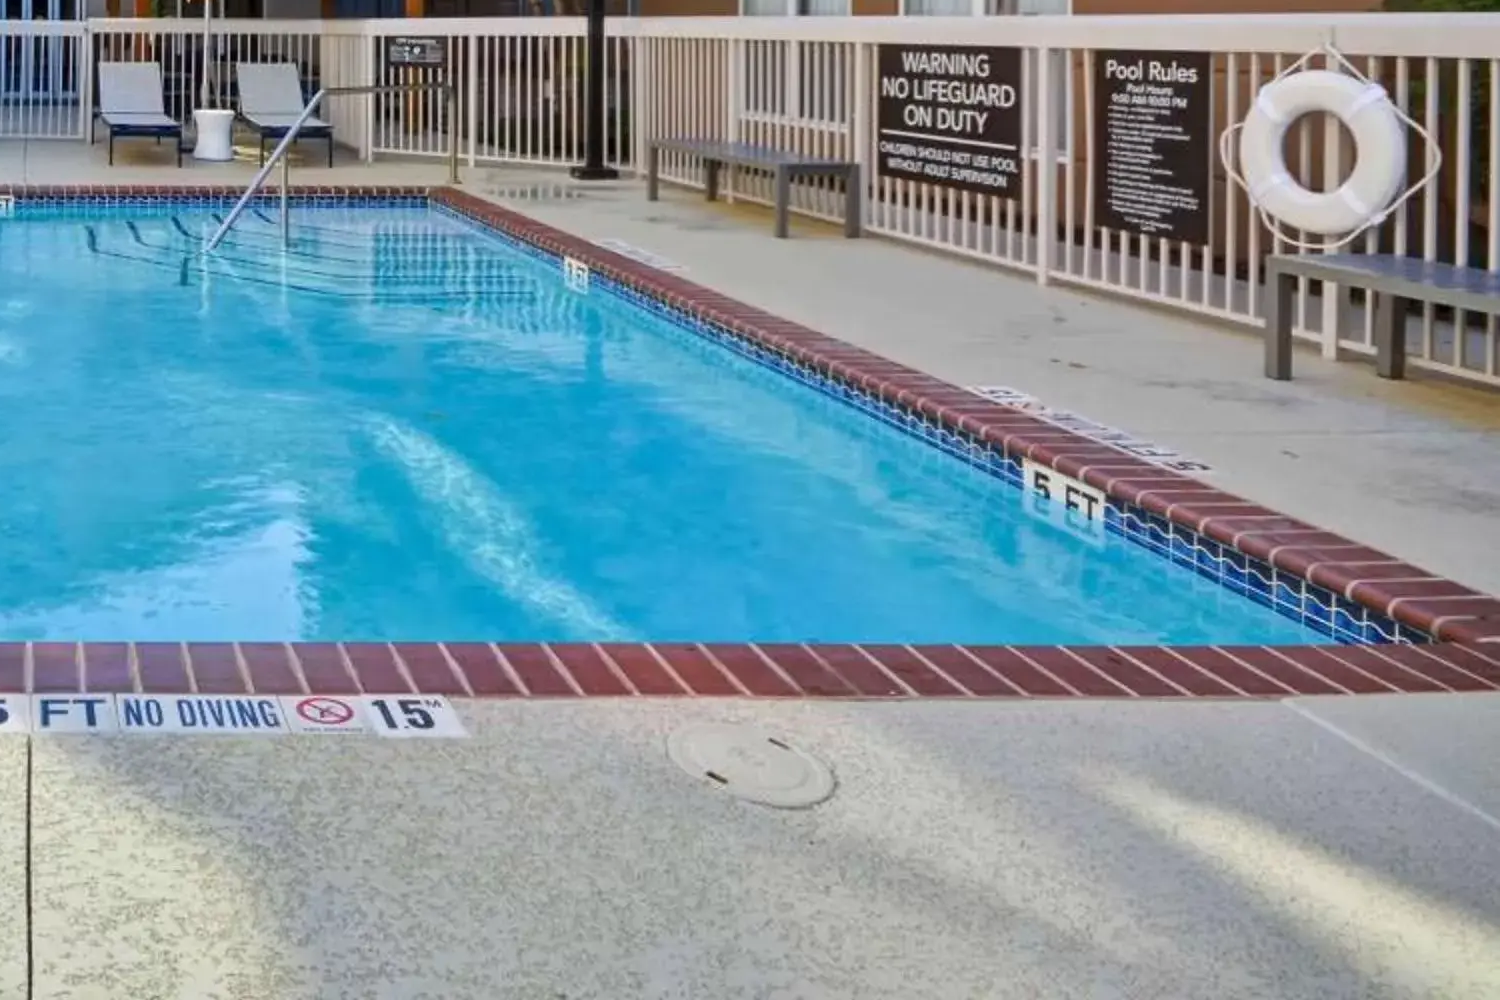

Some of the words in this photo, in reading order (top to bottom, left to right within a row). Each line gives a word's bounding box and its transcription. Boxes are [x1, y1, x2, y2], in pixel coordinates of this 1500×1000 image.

[901, 51, 990, 77] WARNING
[1105, 59, 1143, 81] Pool
[1148, 61, 1198, 83] Rules
[882, 77, 909, 99] NO
[913, 79, 1016, 108] LIFEGUARD
[903, 104, 932, 127] ON
[937, 107, 988, 134] DUTY
[887, 157, 923, 174] WITHOUT
[924, 163, 950, 179] ADULT
[951, 168, 1008, 188] SUPERVISION
[918, 146, 950, 162] SHOULD
[951, 151, 971, 165] NOT
[972, 155, 989, 169] USE
[991, 156, 1019, 174] POOL
[1032, 469, 1052, 501] 5
[1065, 483, 1099, 521] FT
[40, 698, 107, 728] FT
[123, 698, 165, 728] NO
[176, 698, 281, 729] DIVING
